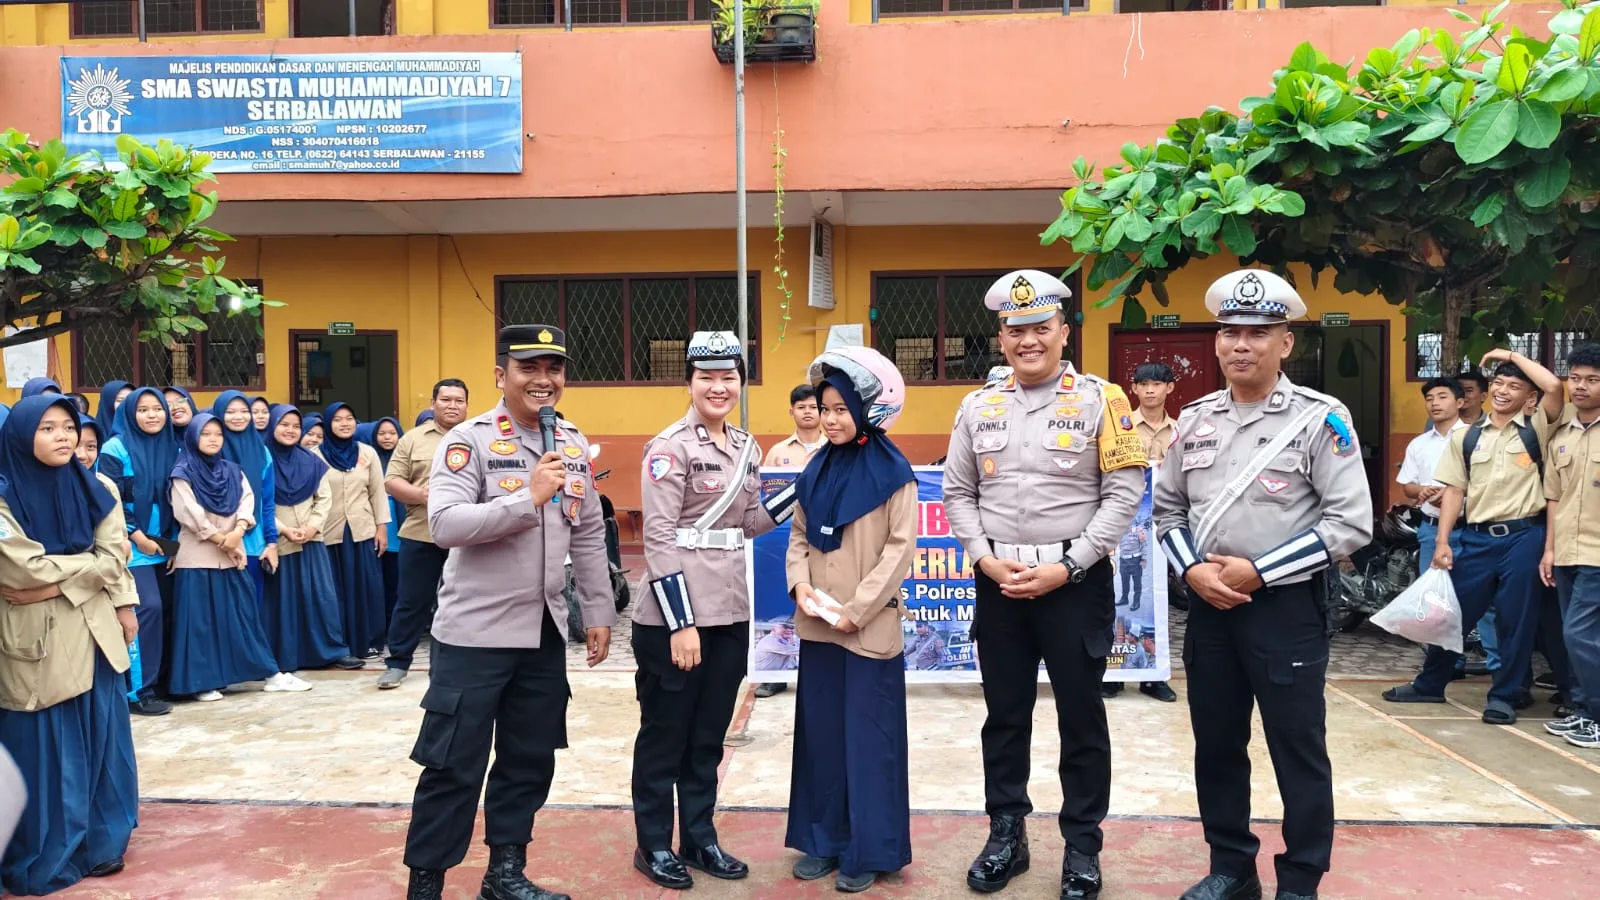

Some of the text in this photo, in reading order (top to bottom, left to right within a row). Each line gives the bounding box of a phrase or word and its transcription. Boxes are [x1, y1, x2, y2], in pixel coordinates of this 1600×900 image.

[169, 60, 481, 74] MAJELIS PENDIDIKAN DASAR DAN MENENGAH MUHAMMADIYAH
[141, 76, 511, 99] SMA SWASTA MUHAMMADIYAH 7
[247, 99, 403, 121] SERBALAWAN
[223, 126, 247, 135] NDS
[336, 125, 366, 134] NPSN
[376, 125, 427, 134] 10202677
[271, 137, 294, 146] NSS
[302, 136, 380, 146] 304070416018
[240, 150, 258, 160] NO.
[261, 150, 274, 159] 16
[276, 150, 302, 159] TELP.
[339, 149, 370, 158] 64143
[373, 149, 445, 158] SERBALAWAN
[454, 149, 485, 158] 21155
[252, 160, 280, 170] email
[288, 159, 400, 170] smamuh7@yahoo.co.id
[1047, 420, 1085, 431] POLRI
[1257, 437, 1302, 449] PRI
[915, 583, 976, 600] Polres
